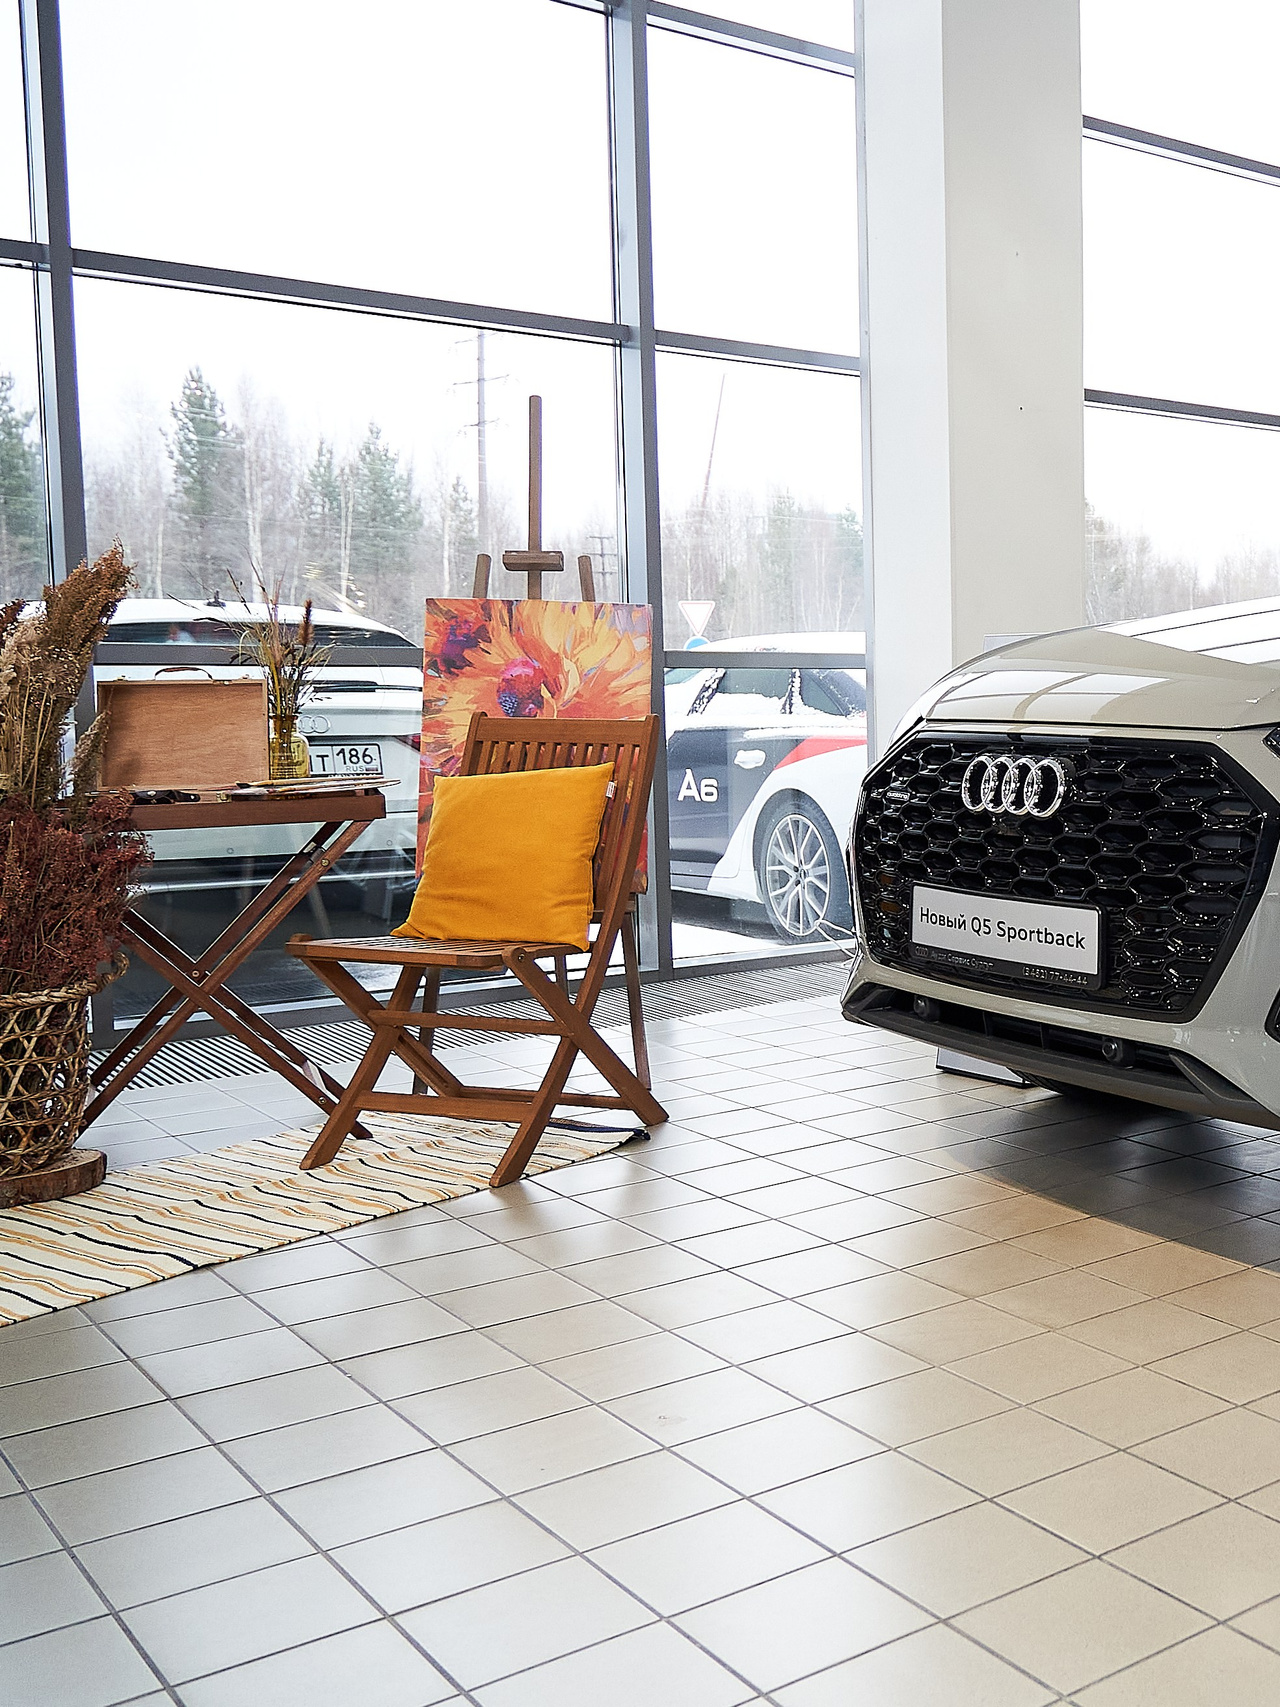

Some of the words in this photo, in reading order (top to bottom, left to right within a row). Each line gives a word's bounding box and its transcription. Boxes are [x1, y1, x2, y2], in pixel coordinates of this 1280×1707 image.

[336, 748, 374, 765] 186
[677, 768, 719, 802] A6
[920, 907, 967, 931] Новый
[971, 916, 991, 936] Q5
[997, 921, 1086, 949] Sportback
